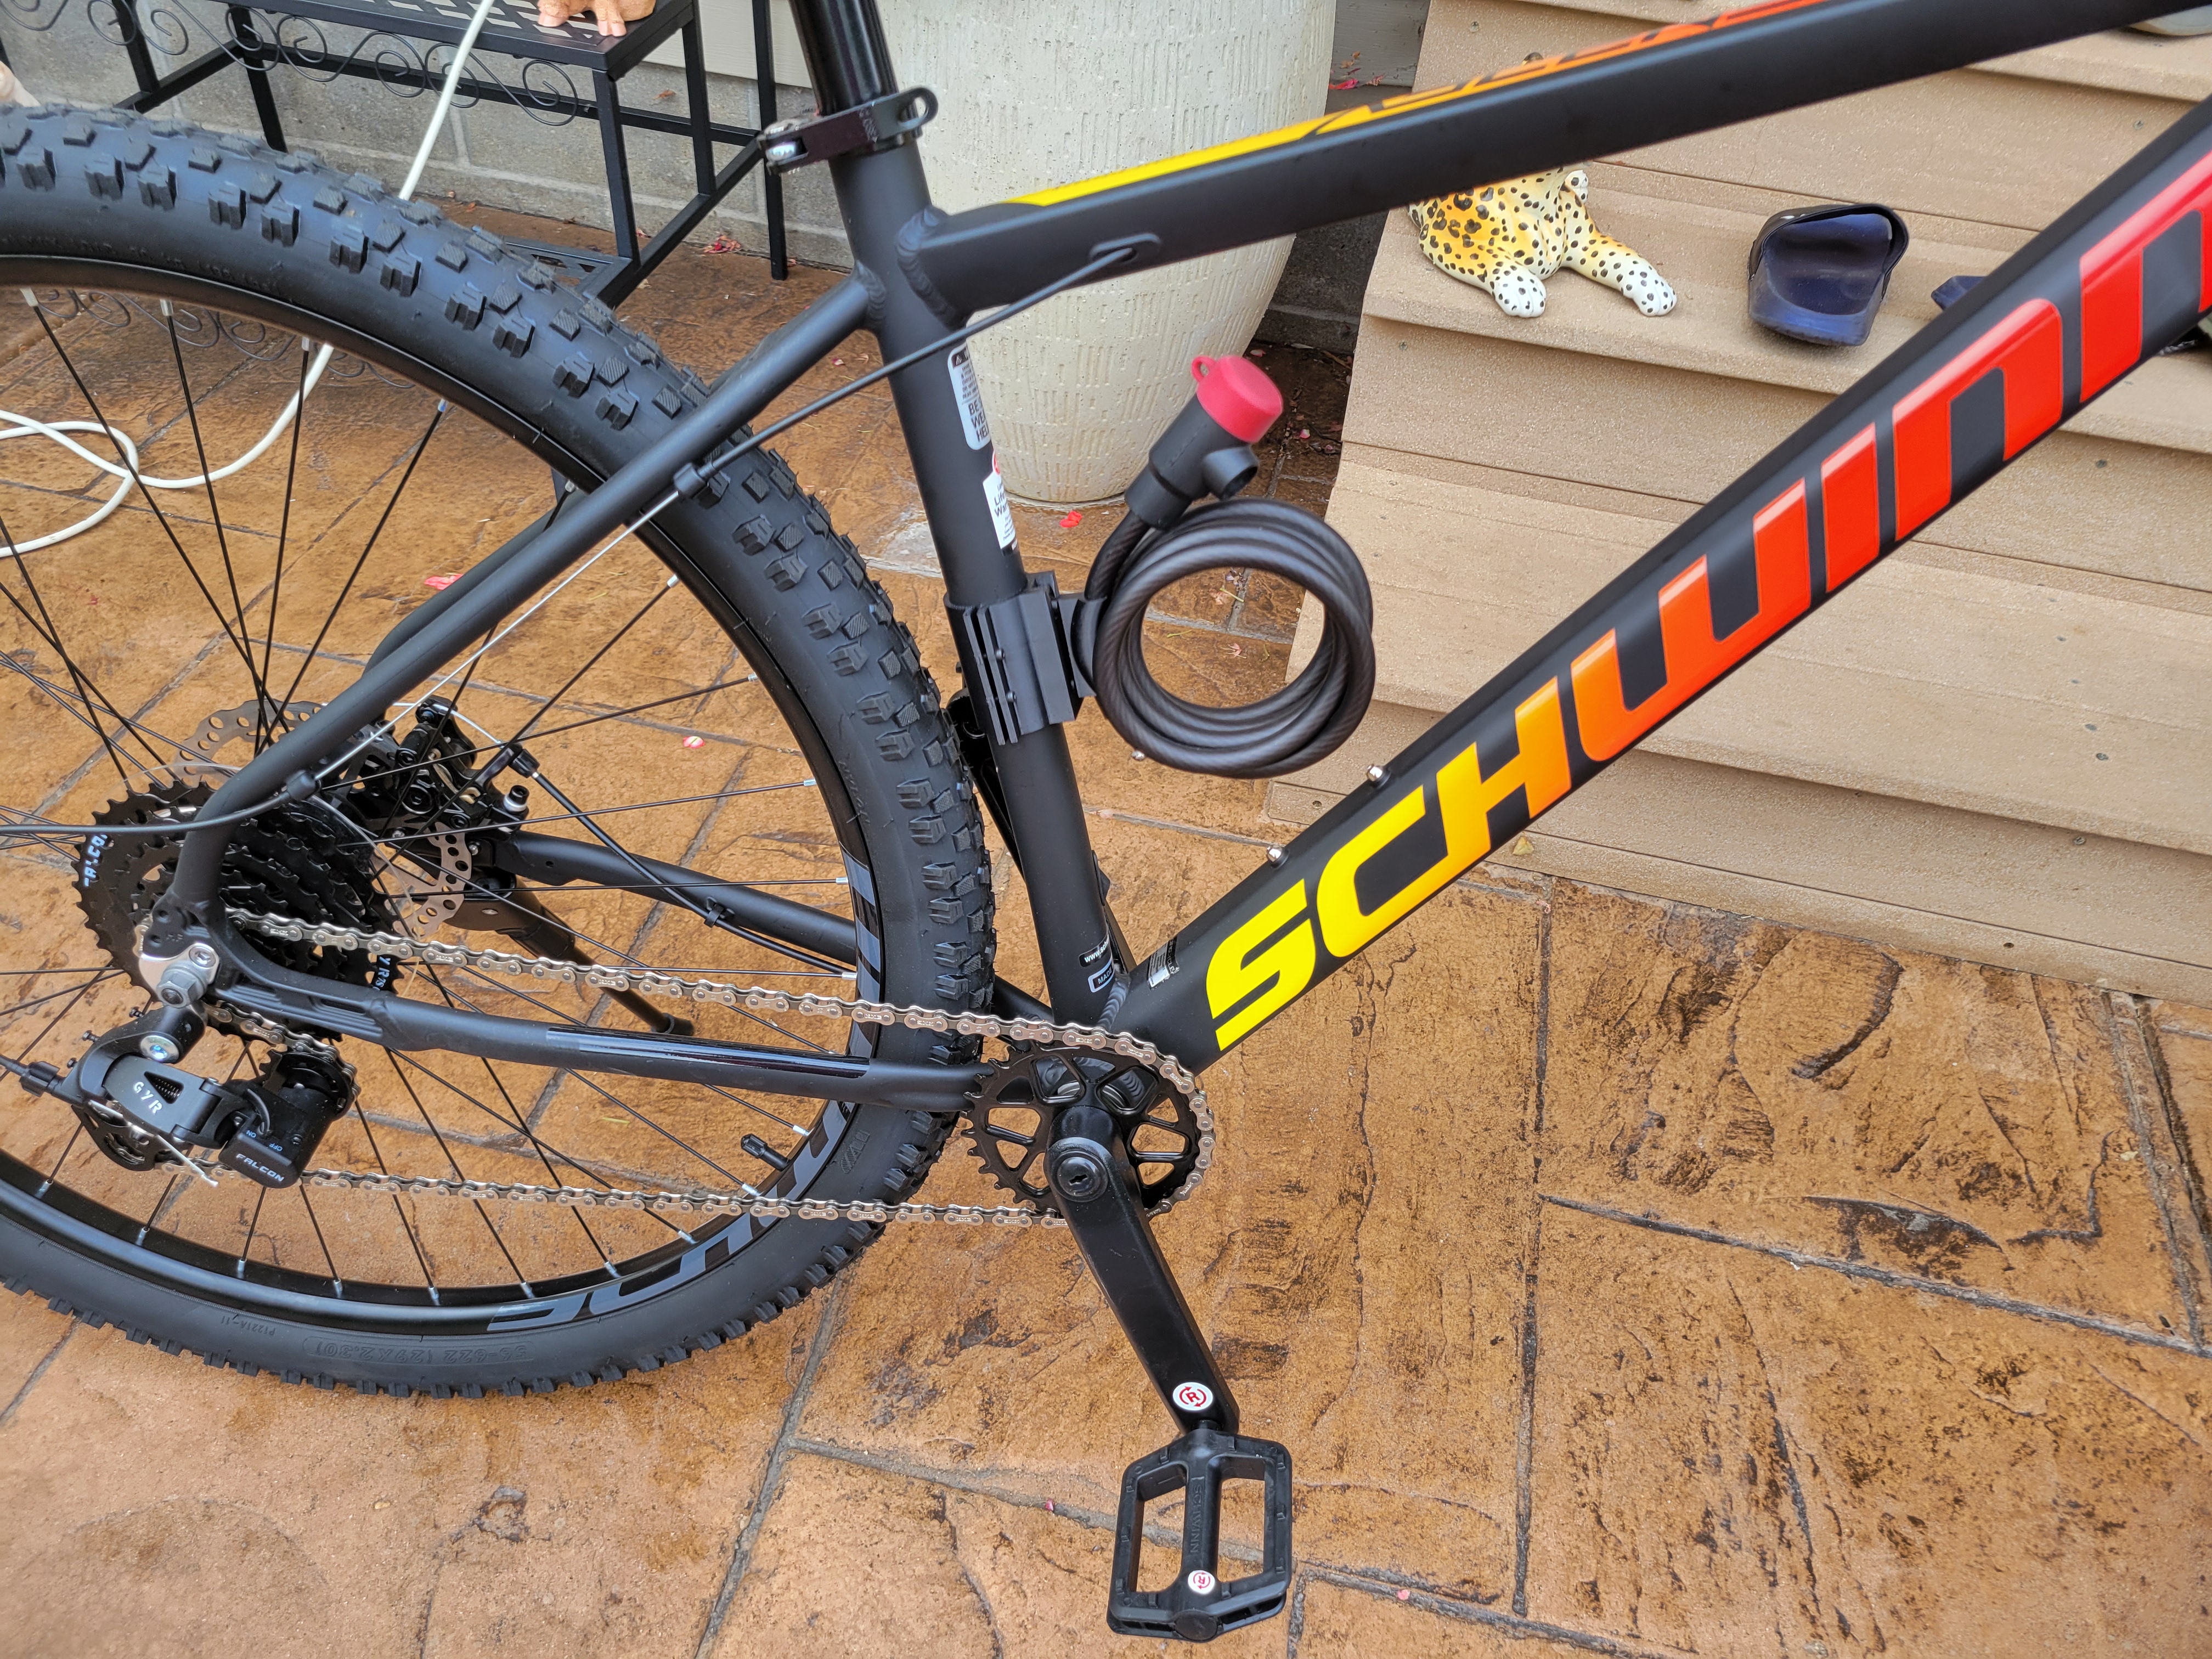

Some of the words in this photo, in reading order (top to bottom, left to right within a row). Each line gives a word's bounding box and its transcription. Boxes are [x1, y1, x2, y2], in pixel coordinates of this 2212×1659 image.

[1206, 150, 2212, 1050] SCHWINN
[1097, 967, 1113, 985] MADE
[134, 1081, 163, 1114] GYR
[246, 1130, 257, 1138] ON
[269, 1143, 283, 1152] OFF
[235, 1153, 285, 1182] FALCON
[444, 1345, 527, 1364] 56-622
[1186, 1392, 1199, 1403] R
[1190, 1483, 1203, 1554] SCHWINN
